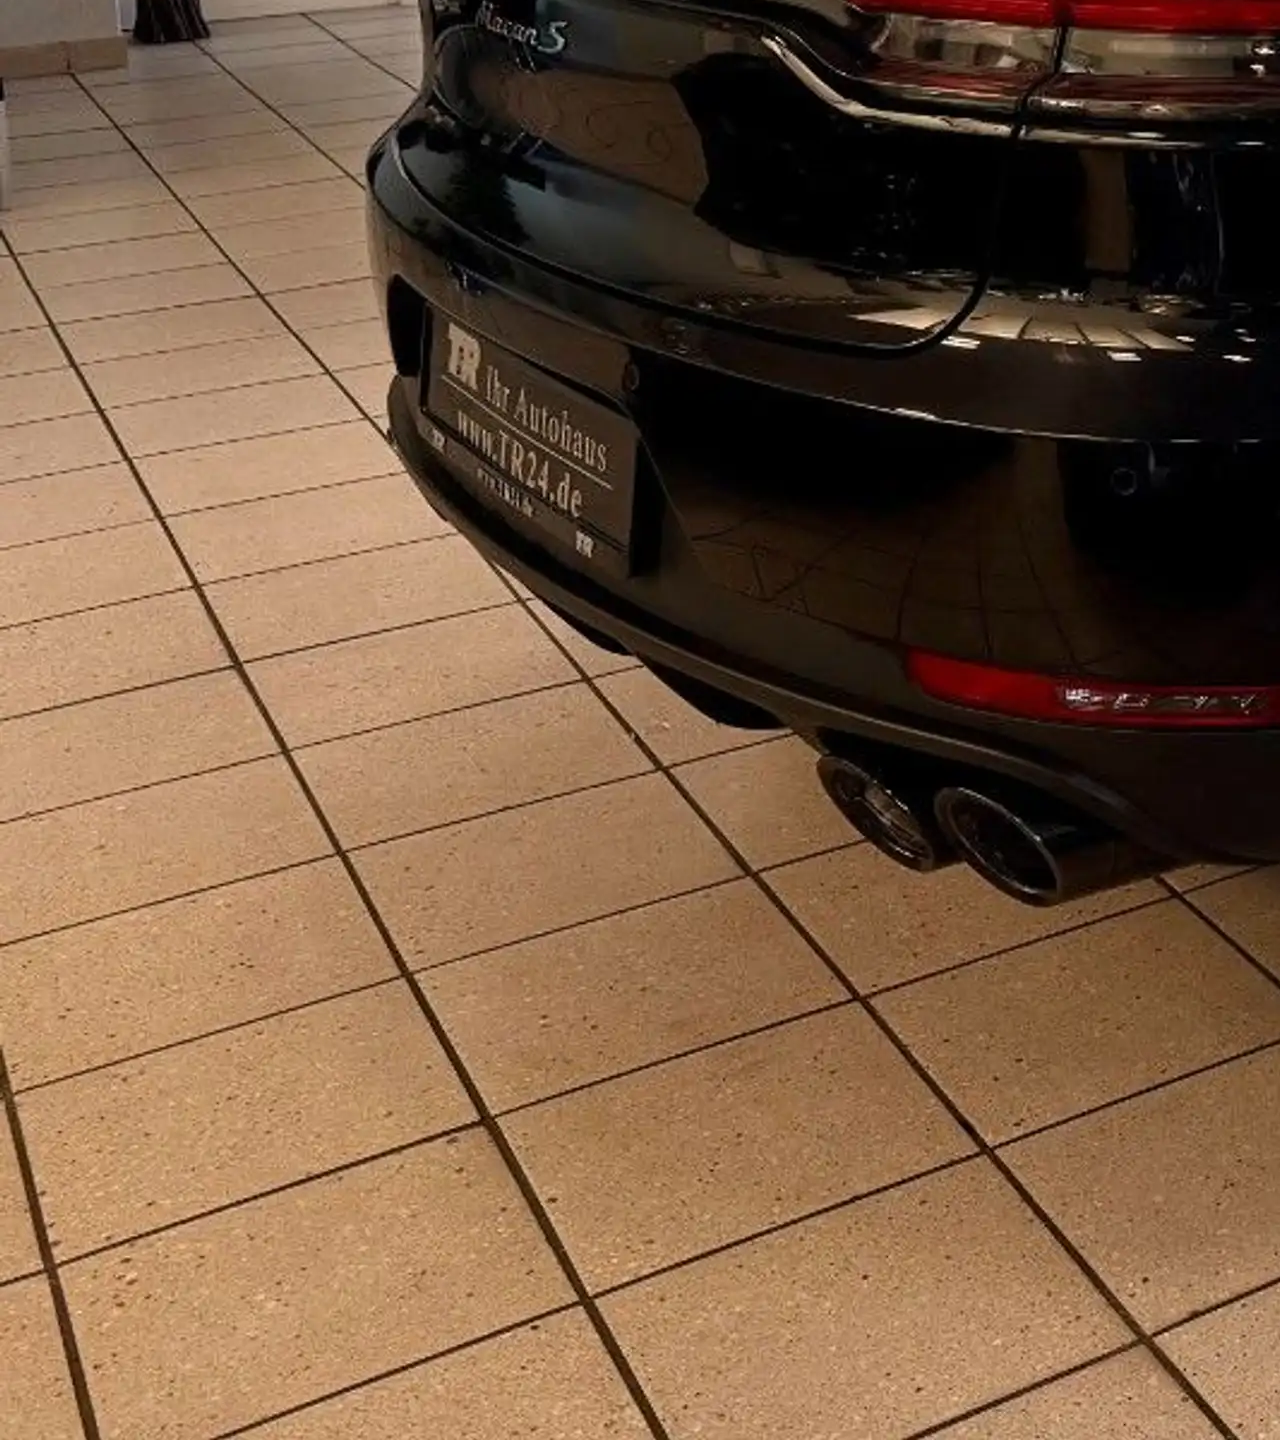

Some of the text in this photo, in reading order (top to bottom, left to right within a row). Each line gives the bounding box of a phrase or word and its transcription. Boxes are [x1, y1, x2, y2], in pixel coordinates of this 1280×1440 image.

[537, 19, 569, 54] S
[456, 410, 584, 518] www.TR24.de
[485, 364, 609, 474] Ihr Autohaus
